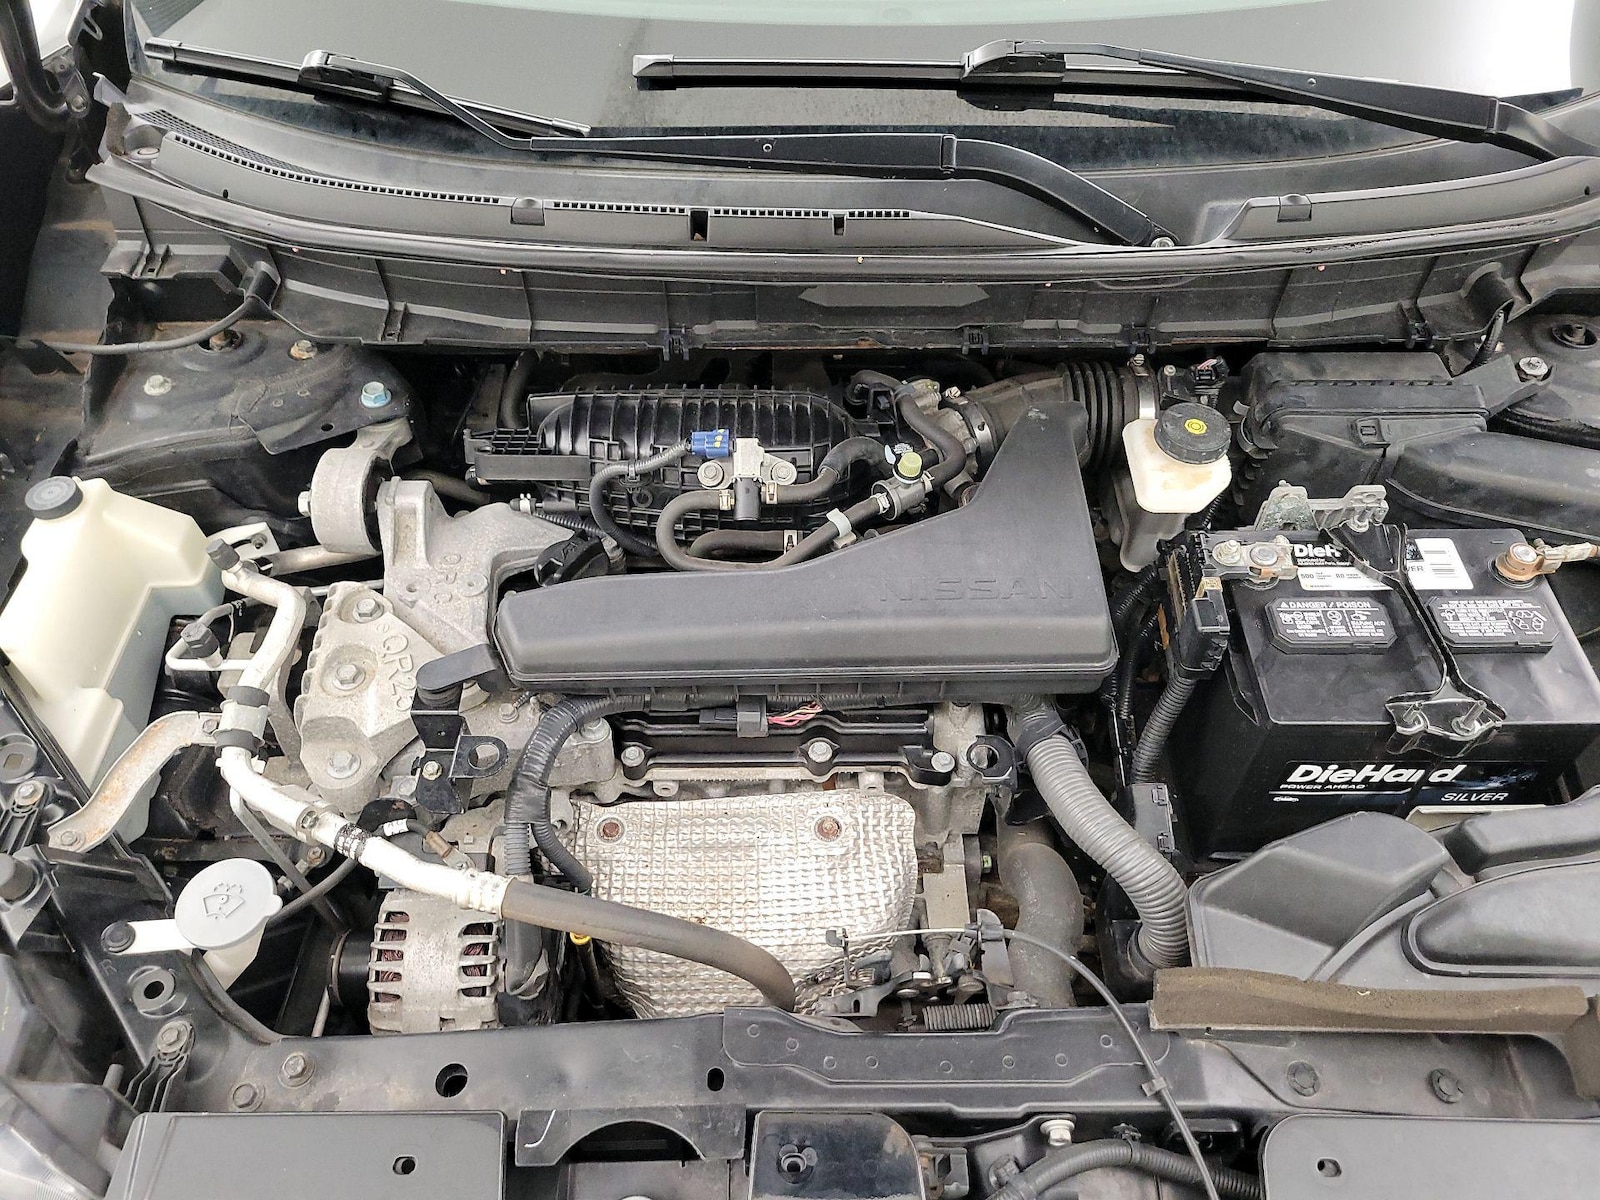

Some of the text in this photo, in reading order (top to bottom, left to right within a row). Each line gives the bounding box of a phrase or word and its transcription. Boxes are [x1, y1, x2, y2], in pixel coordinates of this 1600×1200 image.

[879, 577, 1074, 601] NISSAN
[1289, 601, 1328, 609] DANGER
[1440, 792, 1509, 801] SILVER
